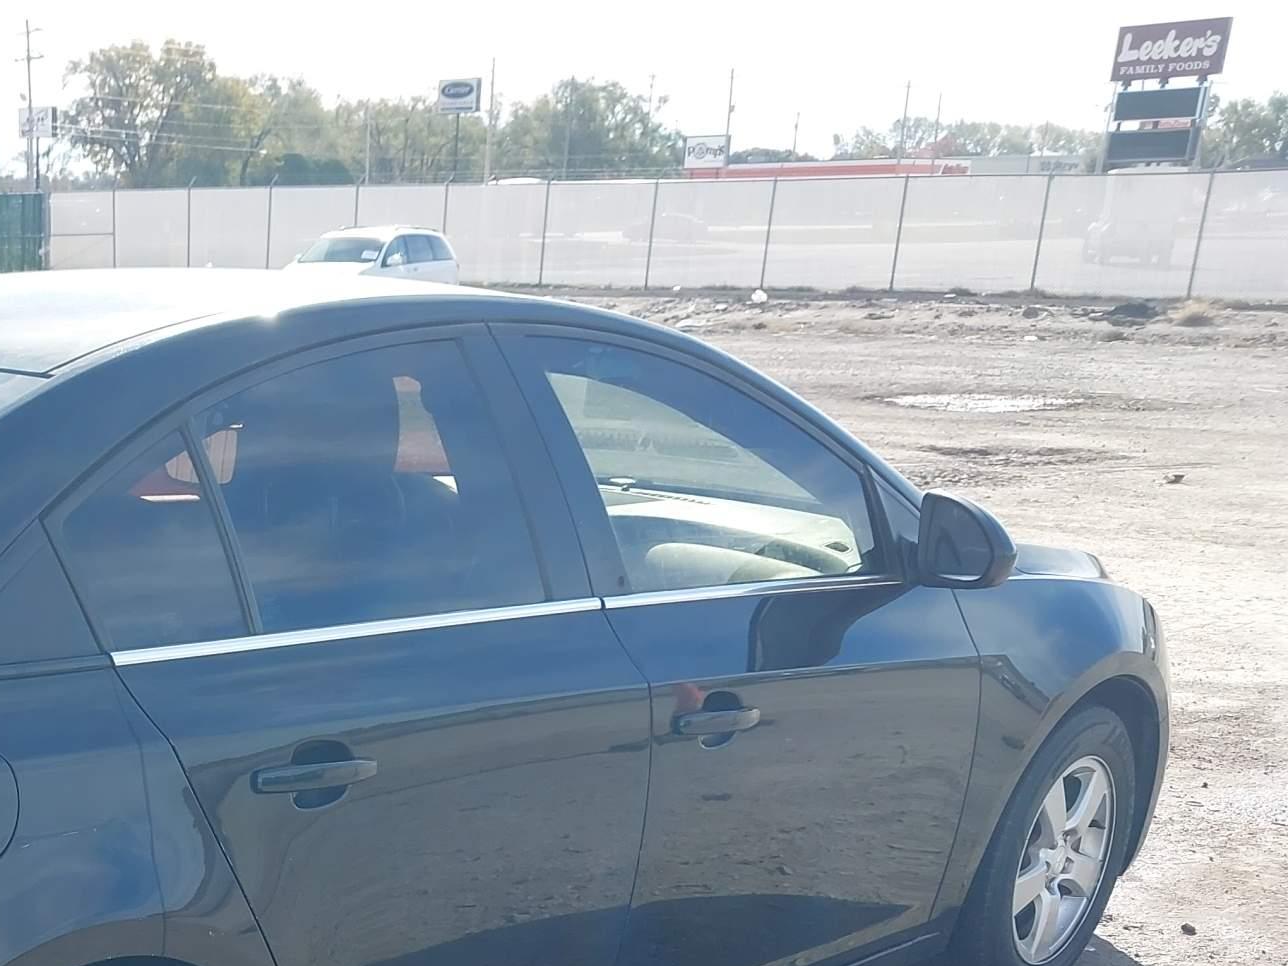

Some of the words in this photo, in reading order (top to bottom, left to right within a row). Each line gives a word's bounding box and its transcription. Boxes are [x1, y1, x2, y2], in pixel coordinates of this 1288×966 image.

[1117, 29, 1222, 63] Leeker's
[1119, 63, 1165, 75] FAMILY
[1167, 60, 1210, 72] FOODS
